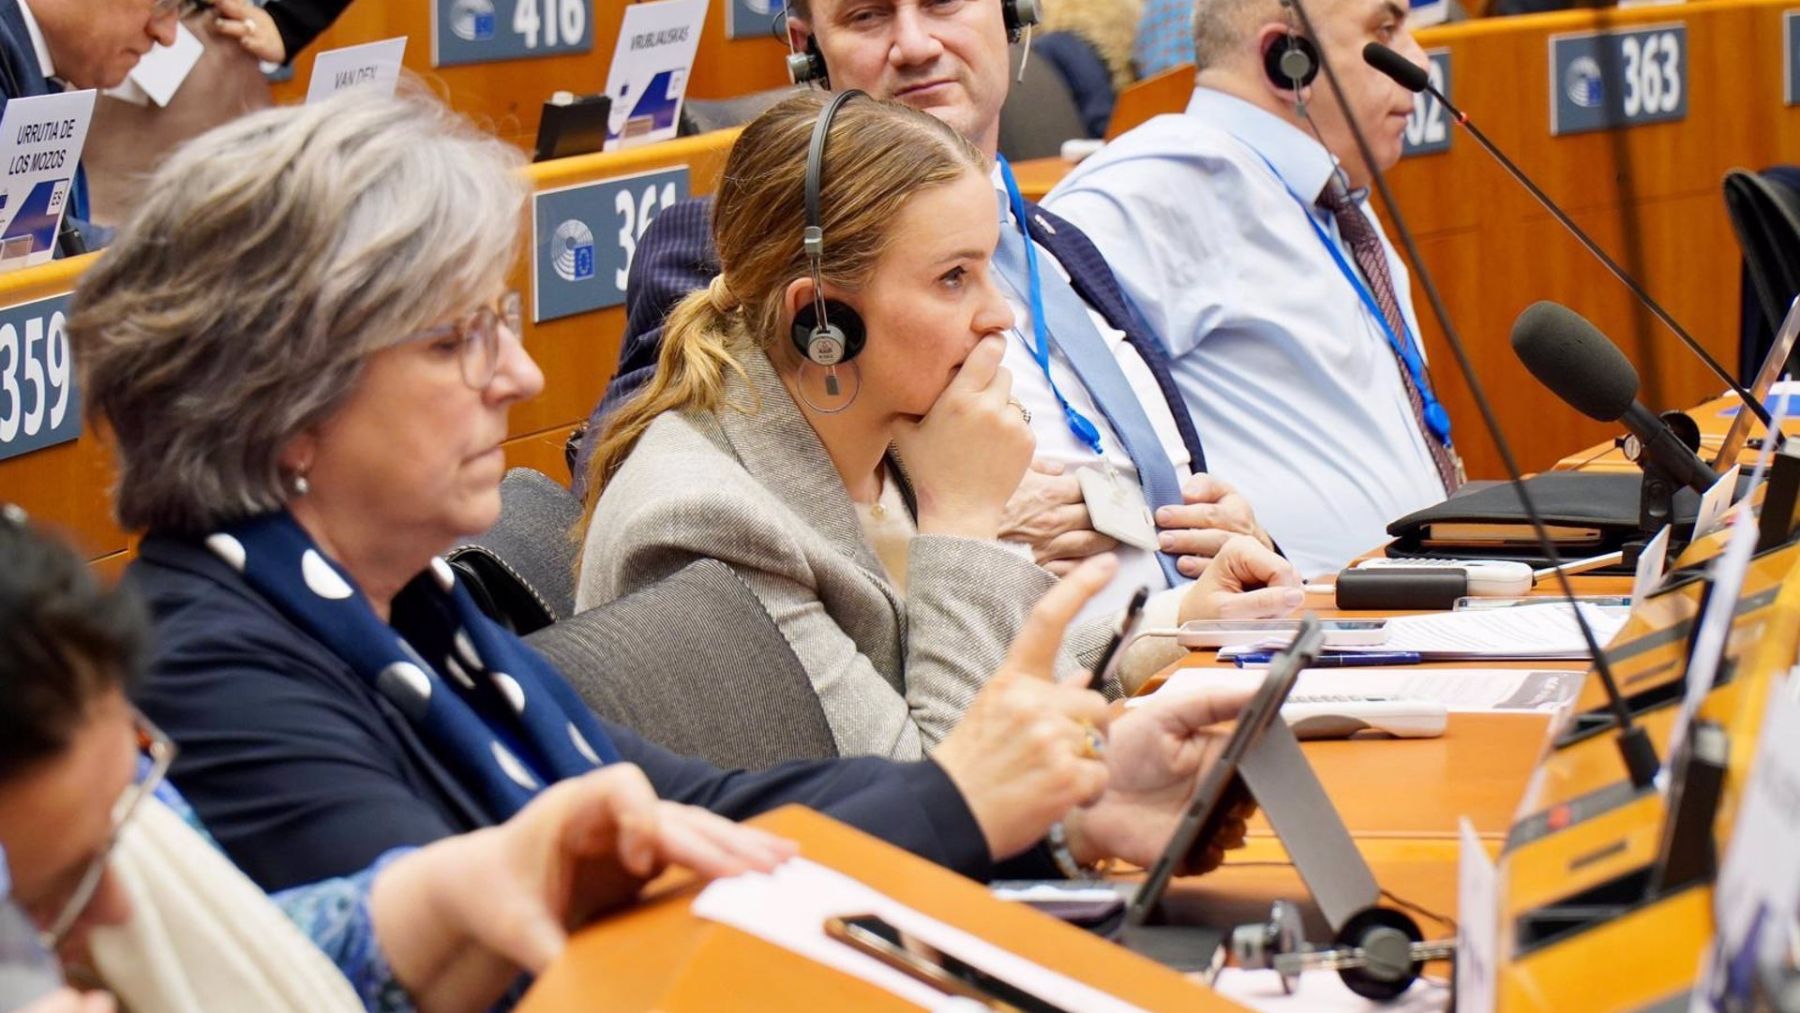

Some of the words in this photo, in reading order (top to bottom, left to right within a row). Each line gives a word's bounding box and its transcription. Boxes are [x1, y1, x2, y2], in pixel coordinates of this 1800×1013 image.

[513, 0, 586, 49] 416
[335, 68, 358, 90] VAN
[1622, 32, 1680, 117] 363
[17, 121, 59, 145] URRUTIA
[60, 119, 75, 138] DE
[9, 154, 30, 175] LOS
[30, 149, 66, 172] MOZOS
[52, 191, 63, 206] ES
[0, 311, 70, 442] 359
